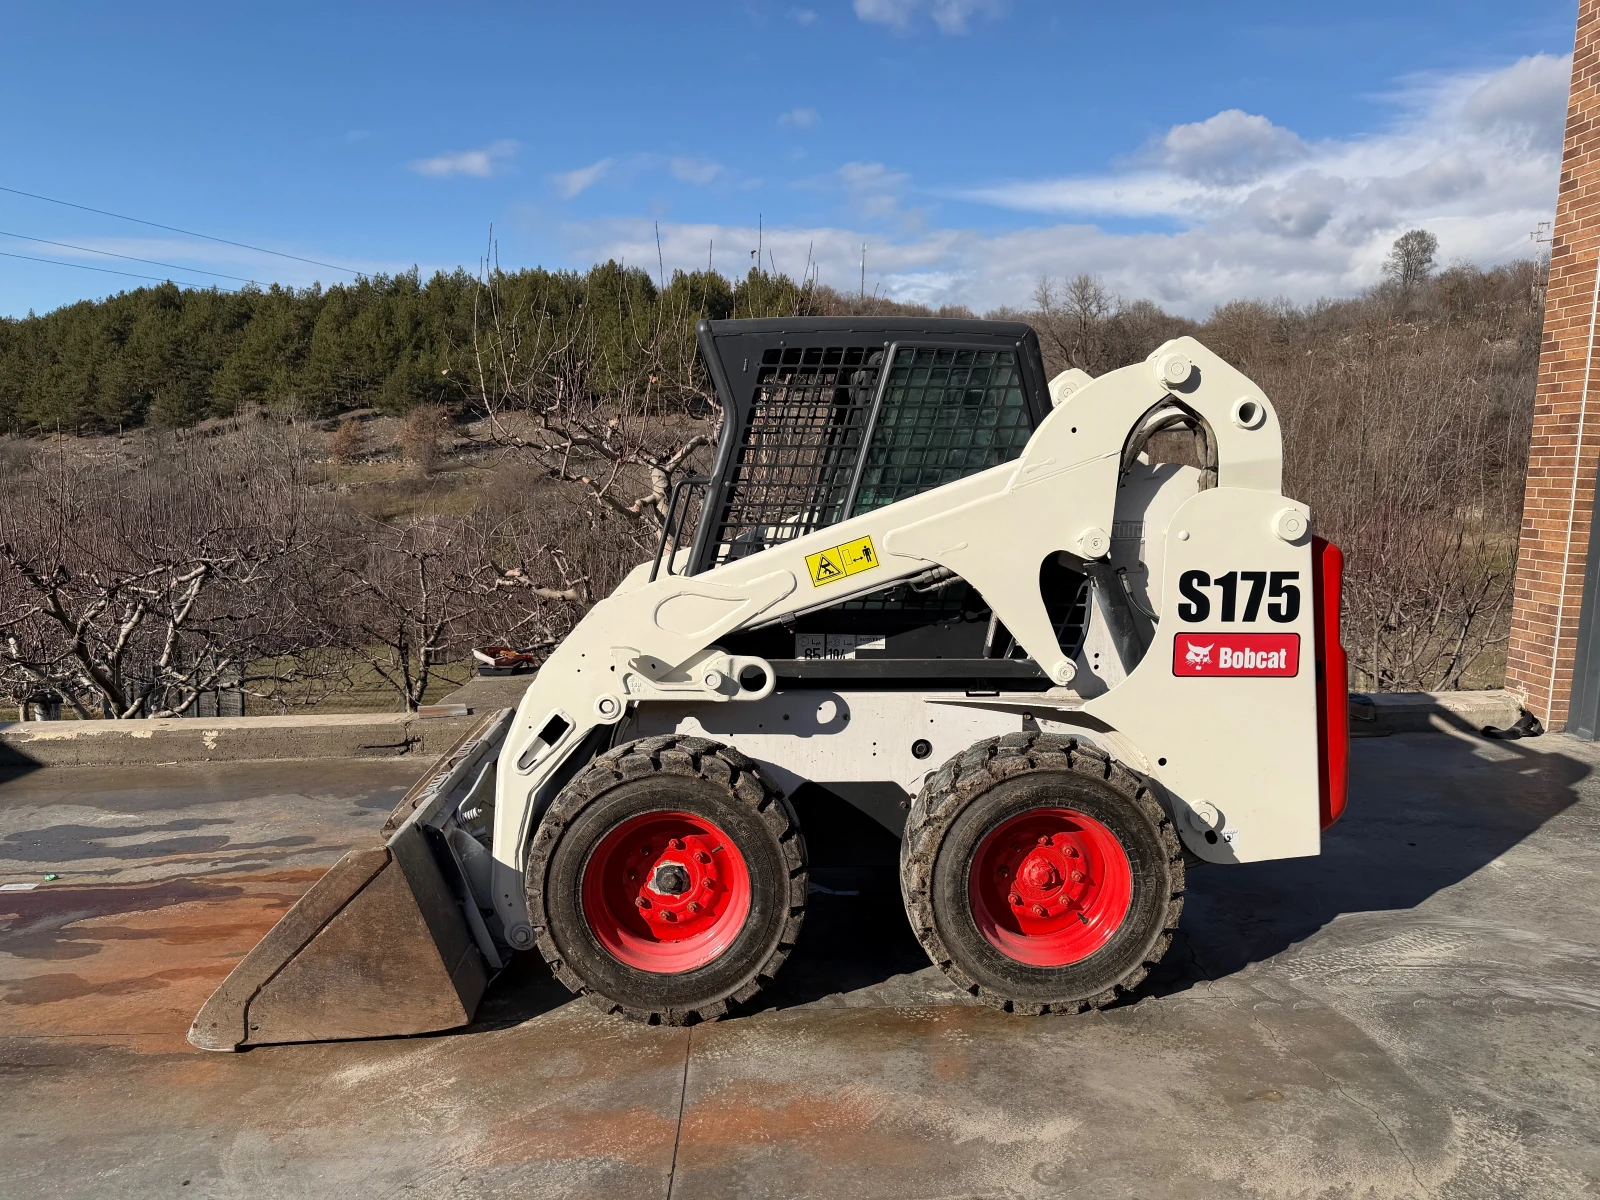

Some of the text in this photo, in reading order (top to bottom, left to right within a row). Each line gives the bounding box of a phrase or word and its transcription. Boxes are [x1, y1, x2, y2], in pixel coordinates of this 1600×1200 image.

[1178, 570, 1300, 623] S175
[804, 648, 821, 660] 85
[1219, 647, 1286, 669] Bobcat
